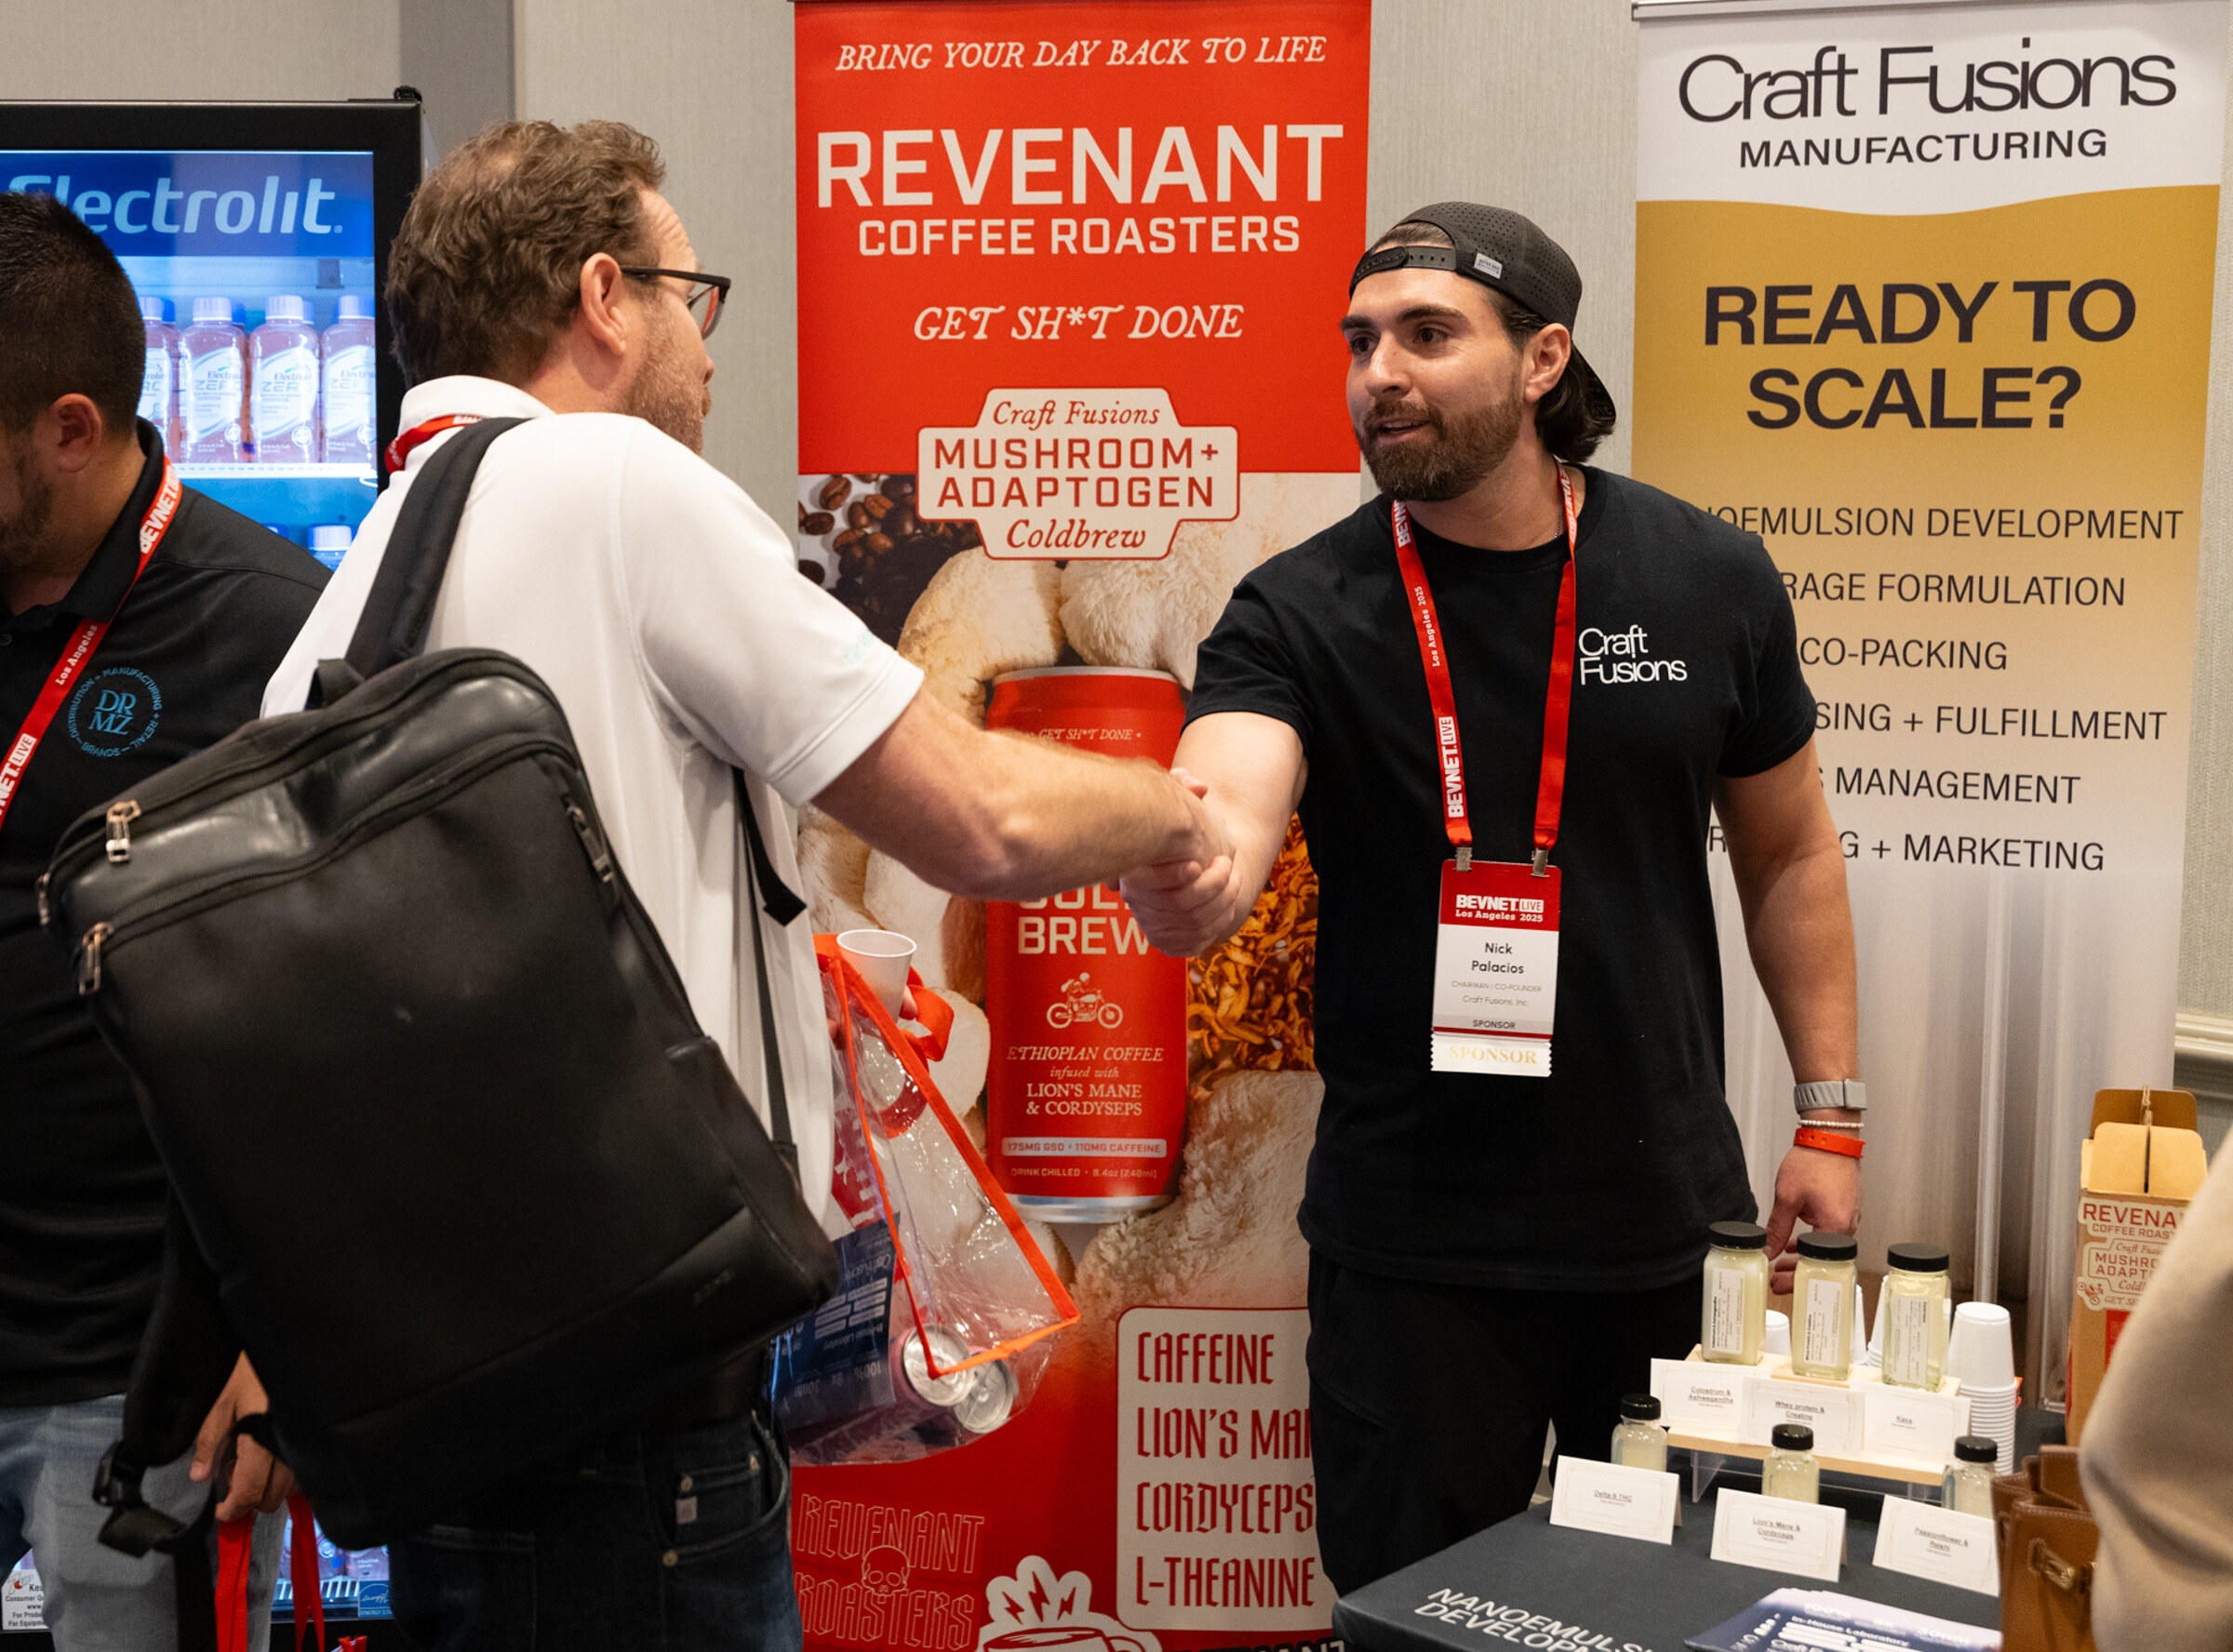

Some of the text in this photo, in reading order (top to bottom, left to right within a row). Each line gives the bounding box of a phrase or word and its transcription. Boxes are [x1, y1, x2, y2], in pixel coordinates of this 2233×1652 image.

[836, 35, 1328, 71] BRING YOUR DAY BACK TO LIFE
[1678, 36, 2177, 123] Craft Fusions
[1740, 128, 2107, 168] MANUFACTURING
[817, 124, 1344, 208] REVENANT
[859, 216, 1300, 256] COFFEE ROASTERS
[914, 306, 1006, 340] GET
[1128, 304, 1244, 339] DONE
[1705, 278, 2137, 347] READY TO
[1745, 366, 2082, 430] SCALE?
[993, 399, 1161, 431] Craft Fusions
[934, 437, 1220, 470] MUSHROOM+
[937, 476, 1213, 508] ADAPTOGEN
[1007, 519, 1146, 550] Coldbrew
[1708, 506, 2183, 540] OEMULSION DEVELOPMENT
[1780, 572, 2126, 606] RAGE FORMULATION
[1414, 586, 1440, 667] Los Angeles 2025
[1578, 623, 1649, 657] Craft
[1799, 637, 2008, 671] CO-PACKING
[56, 667, 73, 686] Los
[1580, 657, 1688, 686] Fusions
[1038, 728, 1065, 739] GET
[1100, 729, 1132, 740] DONE
[1815, 701, 1892, 732] SING
[1935, 707, 2168, 740] FULFILLMENT
[1835, 766, 2081, 805] MANAGEMENT
[1904, 833, 2104, 872] MARKETING
[1455, 909, 1544, 923] Los Angeles 2025
[1519, 899, 1544, 913] LIVE
[1018, 917, 1150, 954] BREW
[1484, 942, 1513, 955] Nick
[1472, 960, 1524, 974] Palacios
[1451, 980, 1490, 990] CHAIRMAN
[1495, 982, 1542, 993] CO-FOUNDER
[1463, 995, 1483, 1005] Craft
[1473, 1019, 1516, 1029] SPONSOR
[1007, 1046, 1164, 1061] ETHIOPIAN COFFEE
[1450, 1046, 1537, 1065] SPONSOR
[1050, 1066, 1119, 1080] infused with
[1026, 1083, 1143, 1099] LION'S MANE
[1026, 1101, 1143, 1116] & CORDYSEPS
[1109, 1143, 1162, 1153] CAFFEINE
[1010, 1168, 1039, 1177] DRINK
[1041, 1168, 1080, 1177] CHILLED
[2082, 1203, 2184, 1229] REVENA
[2093, 1223, 2174, 1240] COFFEE ROAS
[2095, 1265, 2152, 1280] ADAPT
[2119, 1279, 2146, 1291] Cold
[1137, 1332, 1274, 1384] CAFFEINE
[1137, 1407, 1238, 1459] LION'S
[1136, 1482, 1314, 1534] CORDYCEPS
[1136, 1556, 1316, 1607] L-THEANINE
